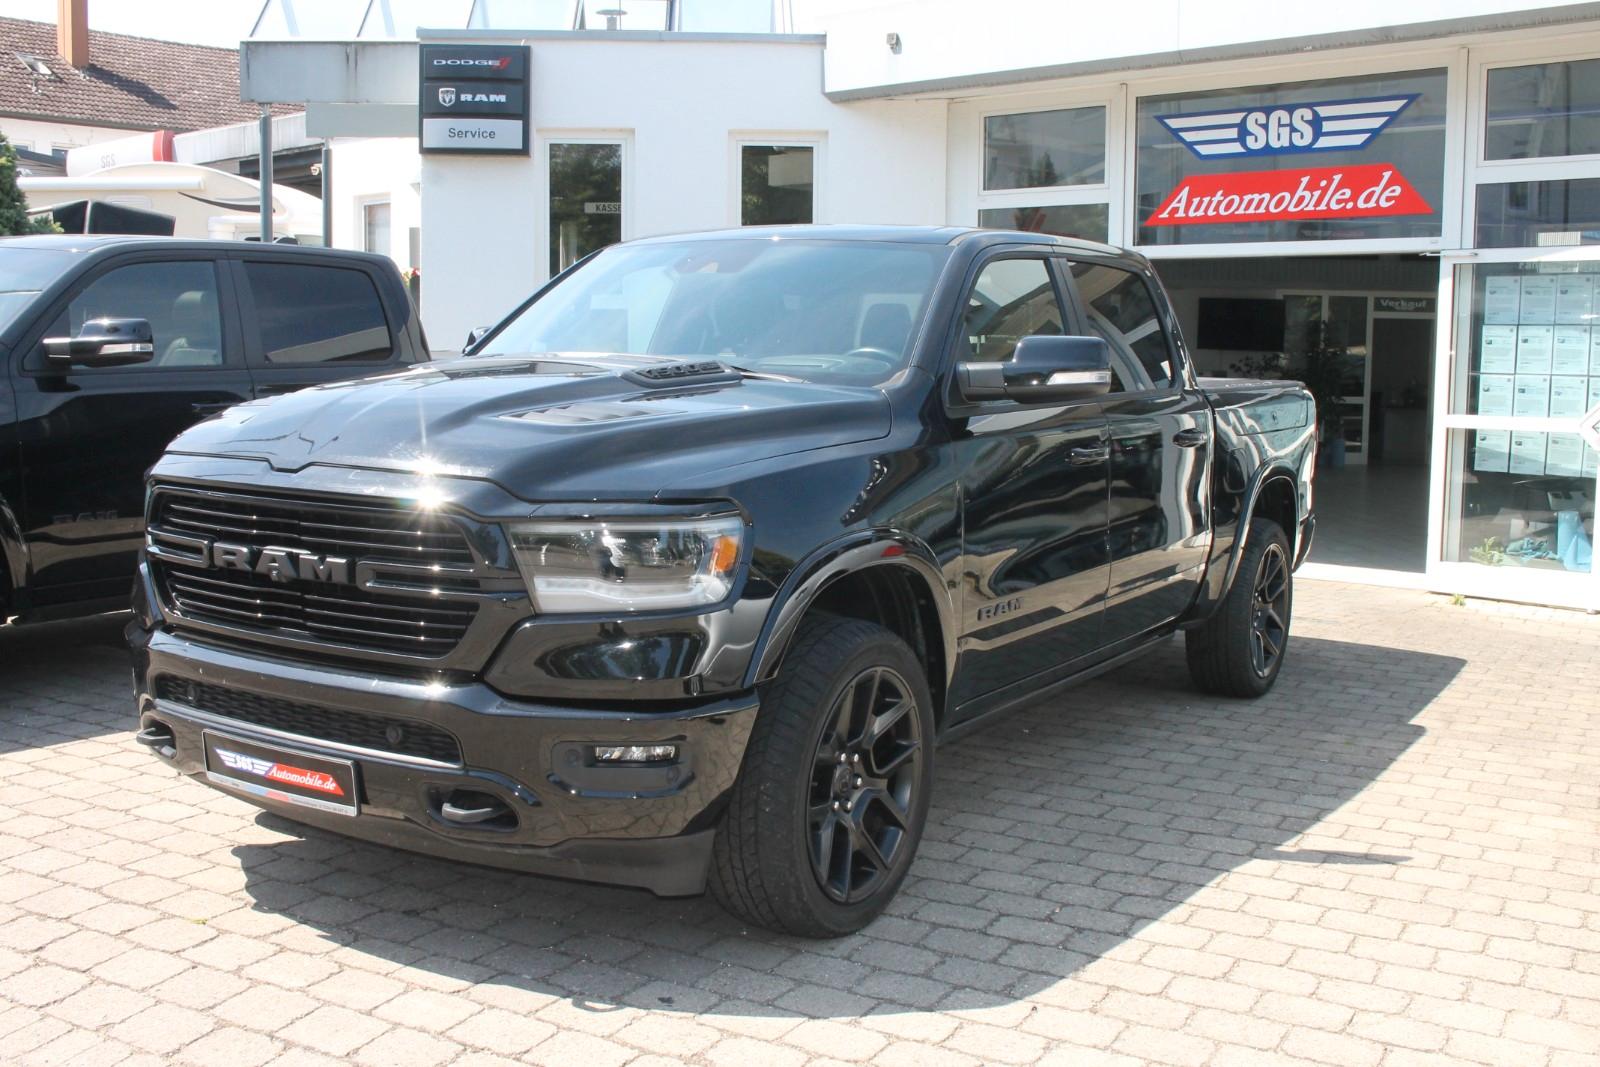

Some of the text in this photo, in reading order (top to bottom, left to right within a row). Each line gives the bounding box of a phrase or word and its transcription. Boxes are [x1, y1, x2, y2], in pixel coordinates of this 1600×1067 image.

[433, 58, 501, 66] DODGE
[460, 93, 507, 103] RAM
[447, 127, 497, 139] Service
[1246, 108, 1313, 150] SGS
[1158, 171, 1401, 218] Automobile.de
[213, 542, 349, 584] RAM
[977, 597, 1024, 621] RAM
[268, 766, 336, 790] Automobile.de
